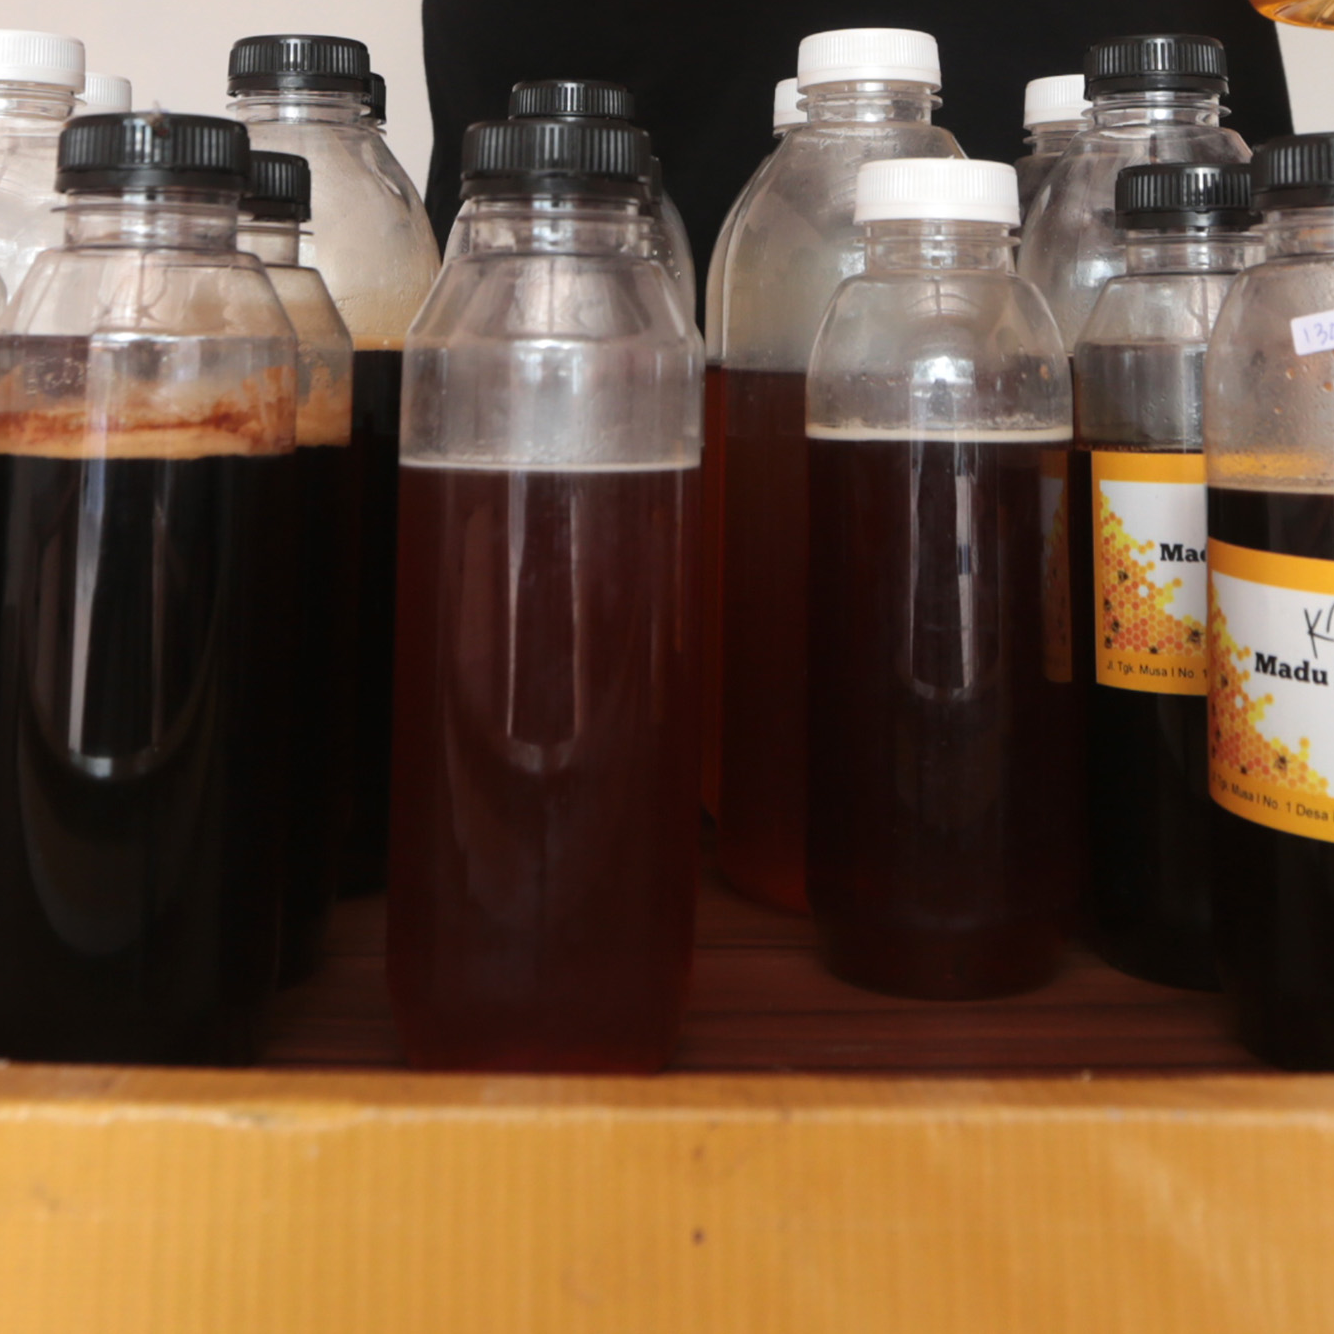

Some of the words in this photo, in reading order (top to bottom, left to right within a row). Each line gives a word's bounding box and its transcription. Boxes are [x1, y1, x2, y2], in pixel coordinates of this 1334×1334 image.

[1139, 664, 1168, 677] Musa
[1254, 652, 1329, 686] Madu
[1231, 783, 1254, 802] Musa
[1296, 804, 1329, 822] Desa
